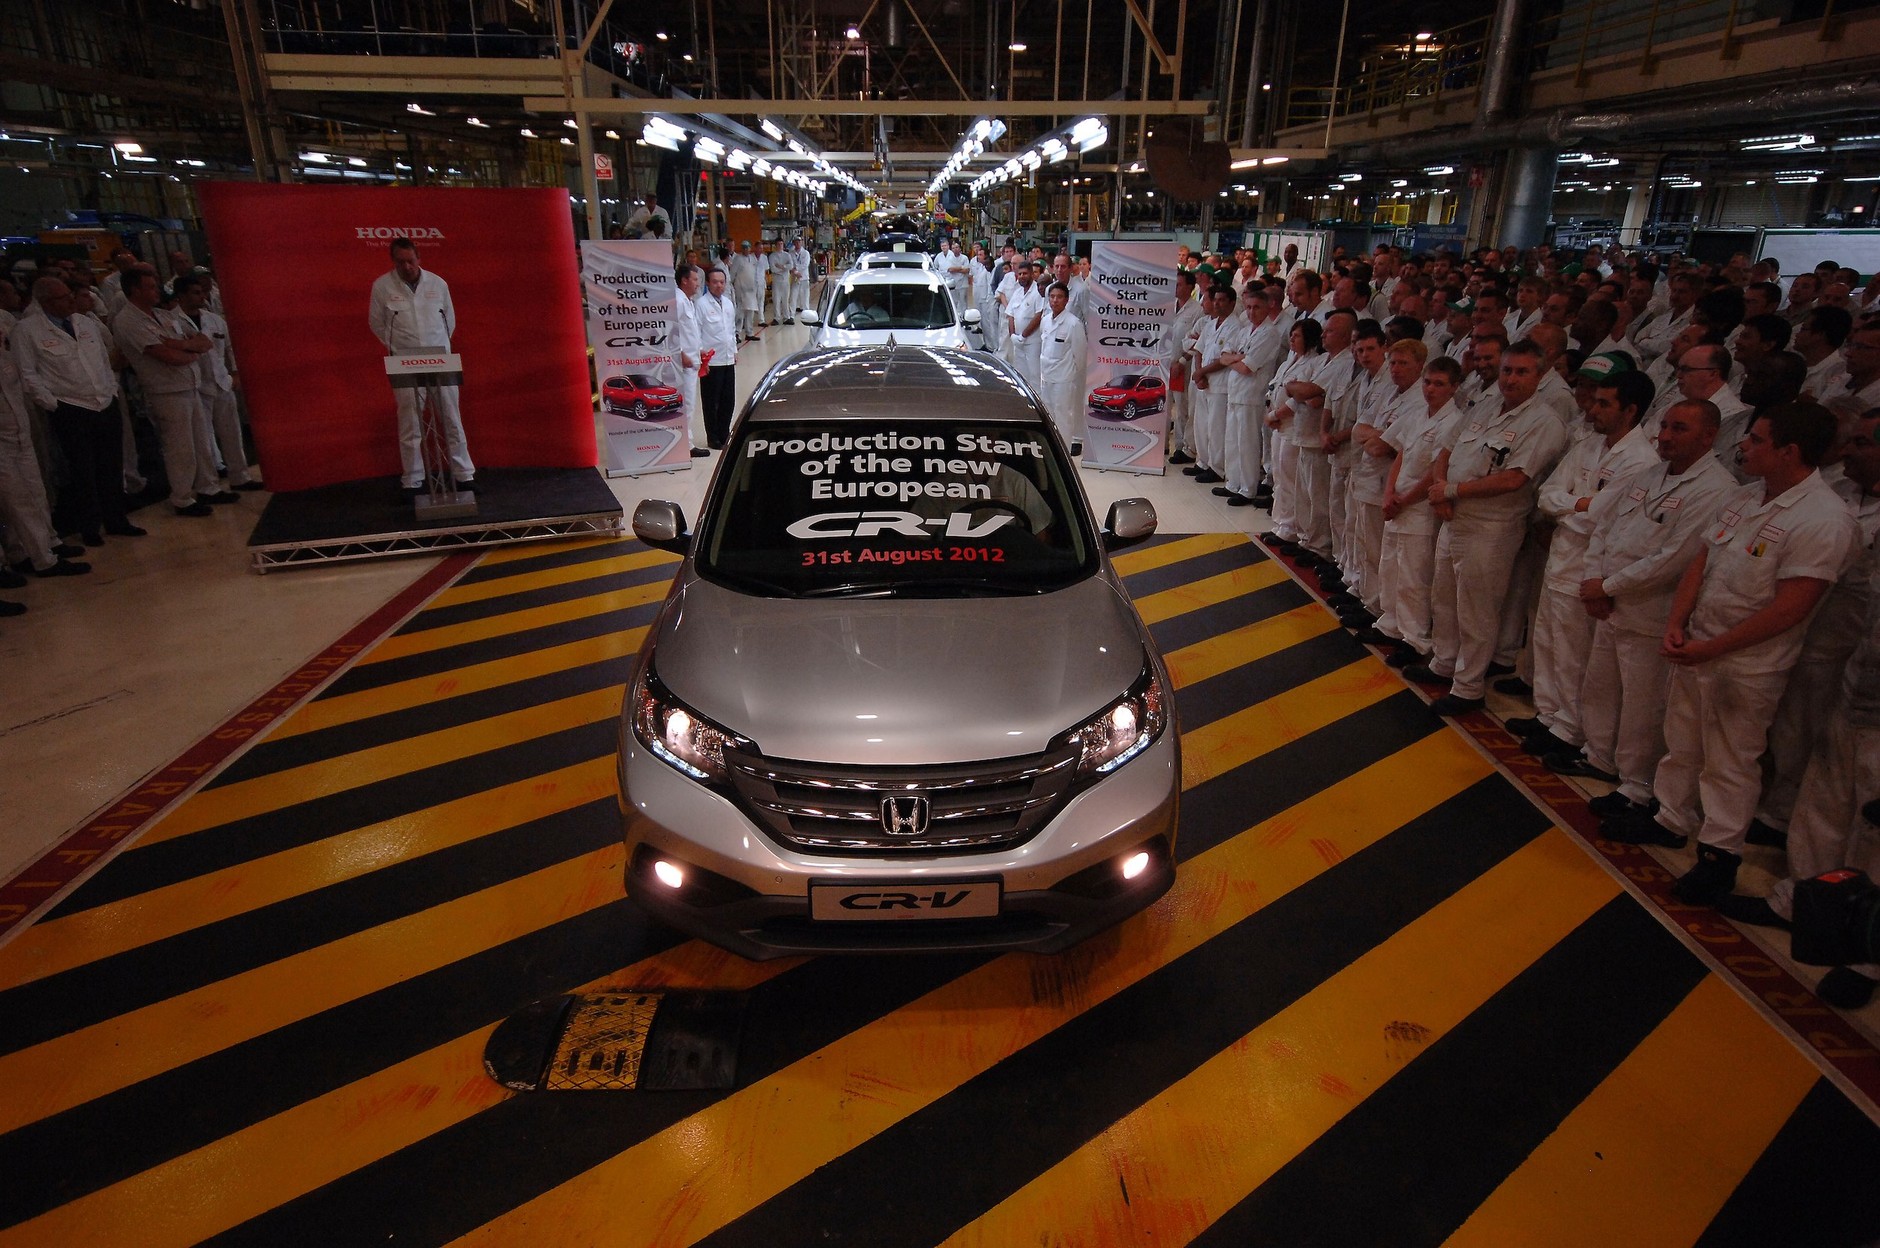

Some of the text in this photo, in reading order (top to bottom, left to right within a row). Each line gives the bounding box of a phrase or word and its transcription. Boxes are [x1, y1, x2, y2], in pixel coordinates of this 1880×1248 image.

[355, 227, 445, 239] HONDA
[594, 272, 667, 285] Production
[1098, 274, 1169, 286] Production
[616, 288, 649, 300] Start
[1117, 289, 1148, 301] Start
[598, 303, 669, 316] of the new
[1097, 303, 1166, 317] of the new
[604, 320, 666, 332] European
[1101, 319, 1160, 333] European
[604, 335, 668, 348] CR-V
[1098, 336, 1160, 348] CR-V
[401, 358, 447, 367] HONDA
[607, 355, 671, 367] 31st August 2012
[1097, 356, 1160, 367] 31st August 2012
[746, 431, 1044, 459] Production Start
[800, 452, 1001, 478] of the new
[811, 479, 992, 502] European
[785, 510, 1016, 539] CR-V
[801, 546, 1006, 567] 31st August 2012
[214, 644, 364, 740] PROCESS
[839, 890, 972, 910] CR-V
